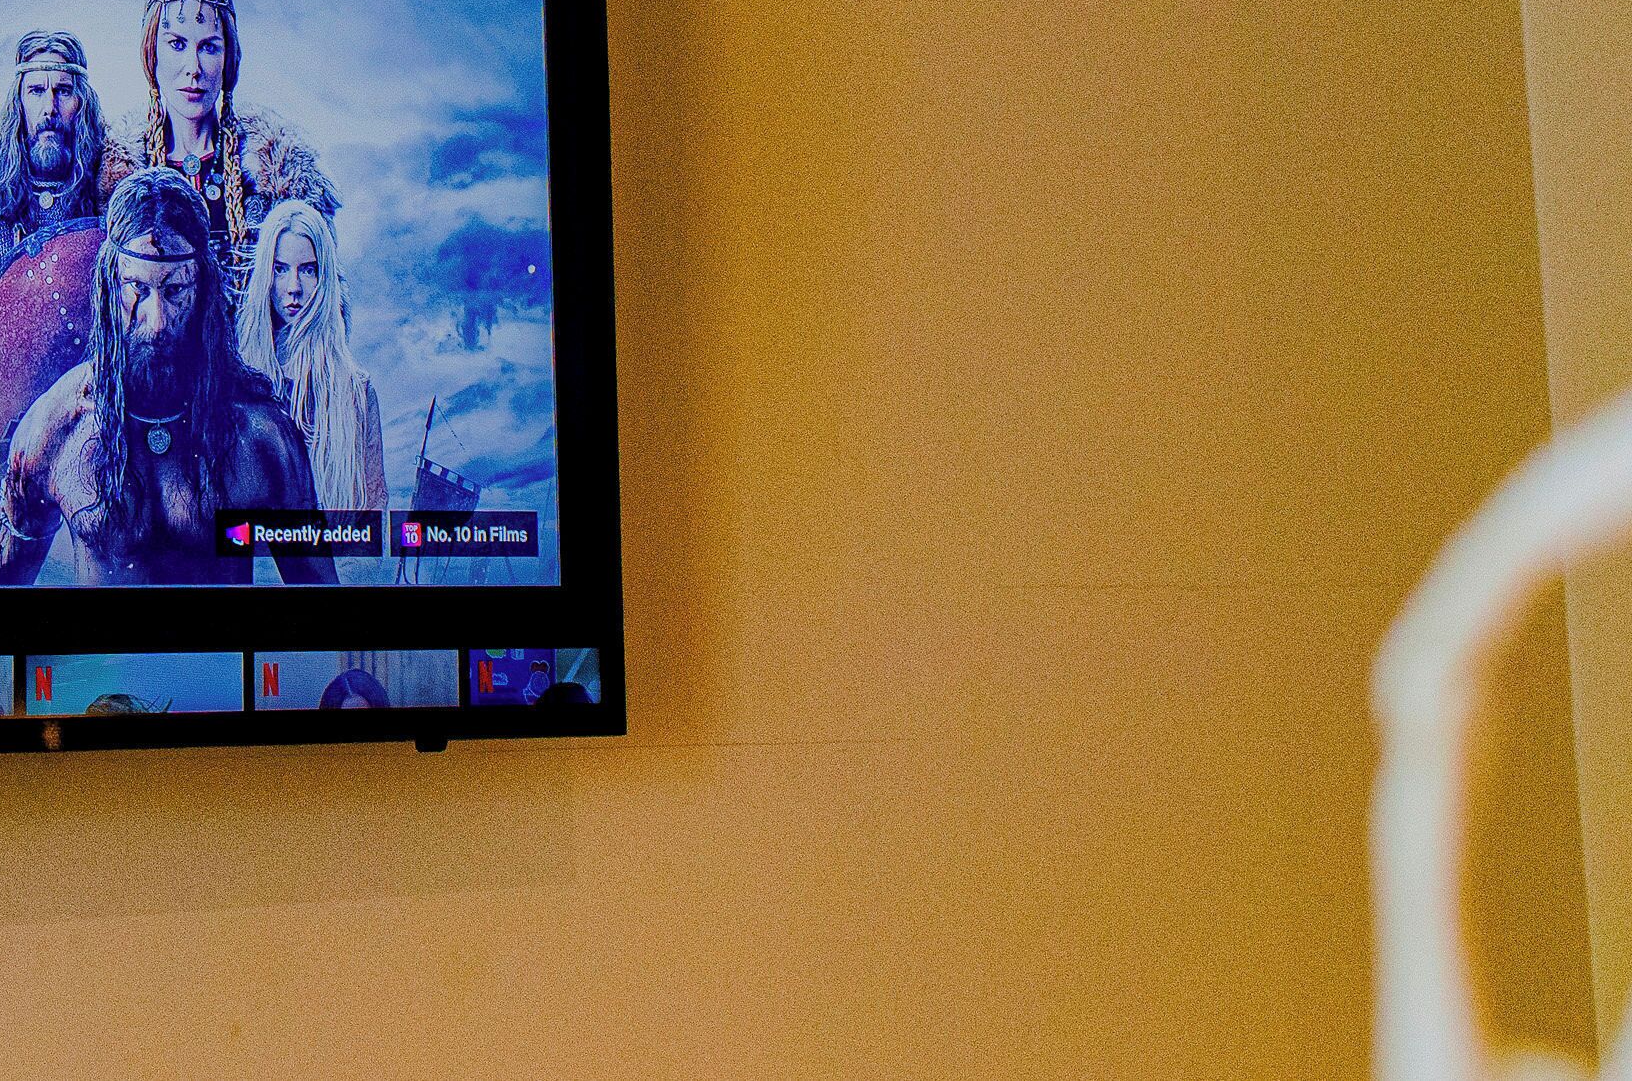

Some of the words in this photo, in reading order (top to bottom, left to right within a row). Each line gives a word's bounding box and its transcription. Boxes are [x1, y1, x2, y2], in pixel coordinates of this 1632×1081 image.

[254, 524, 321, 546] Recently
[323, 525, 371, 543] added
[404, 524, 418, 532] TOP
[405, 532, 418, 544] 10
[427, 526, 451, 543] No.
[453, 526, 472, 543] 10
[473, 526, 487, 543] in
[489, 526, 528, 543] Films
[35, 666, 52, 701] N
[263, 662, 279, 697] N
[478, 660, 494, 694] N
